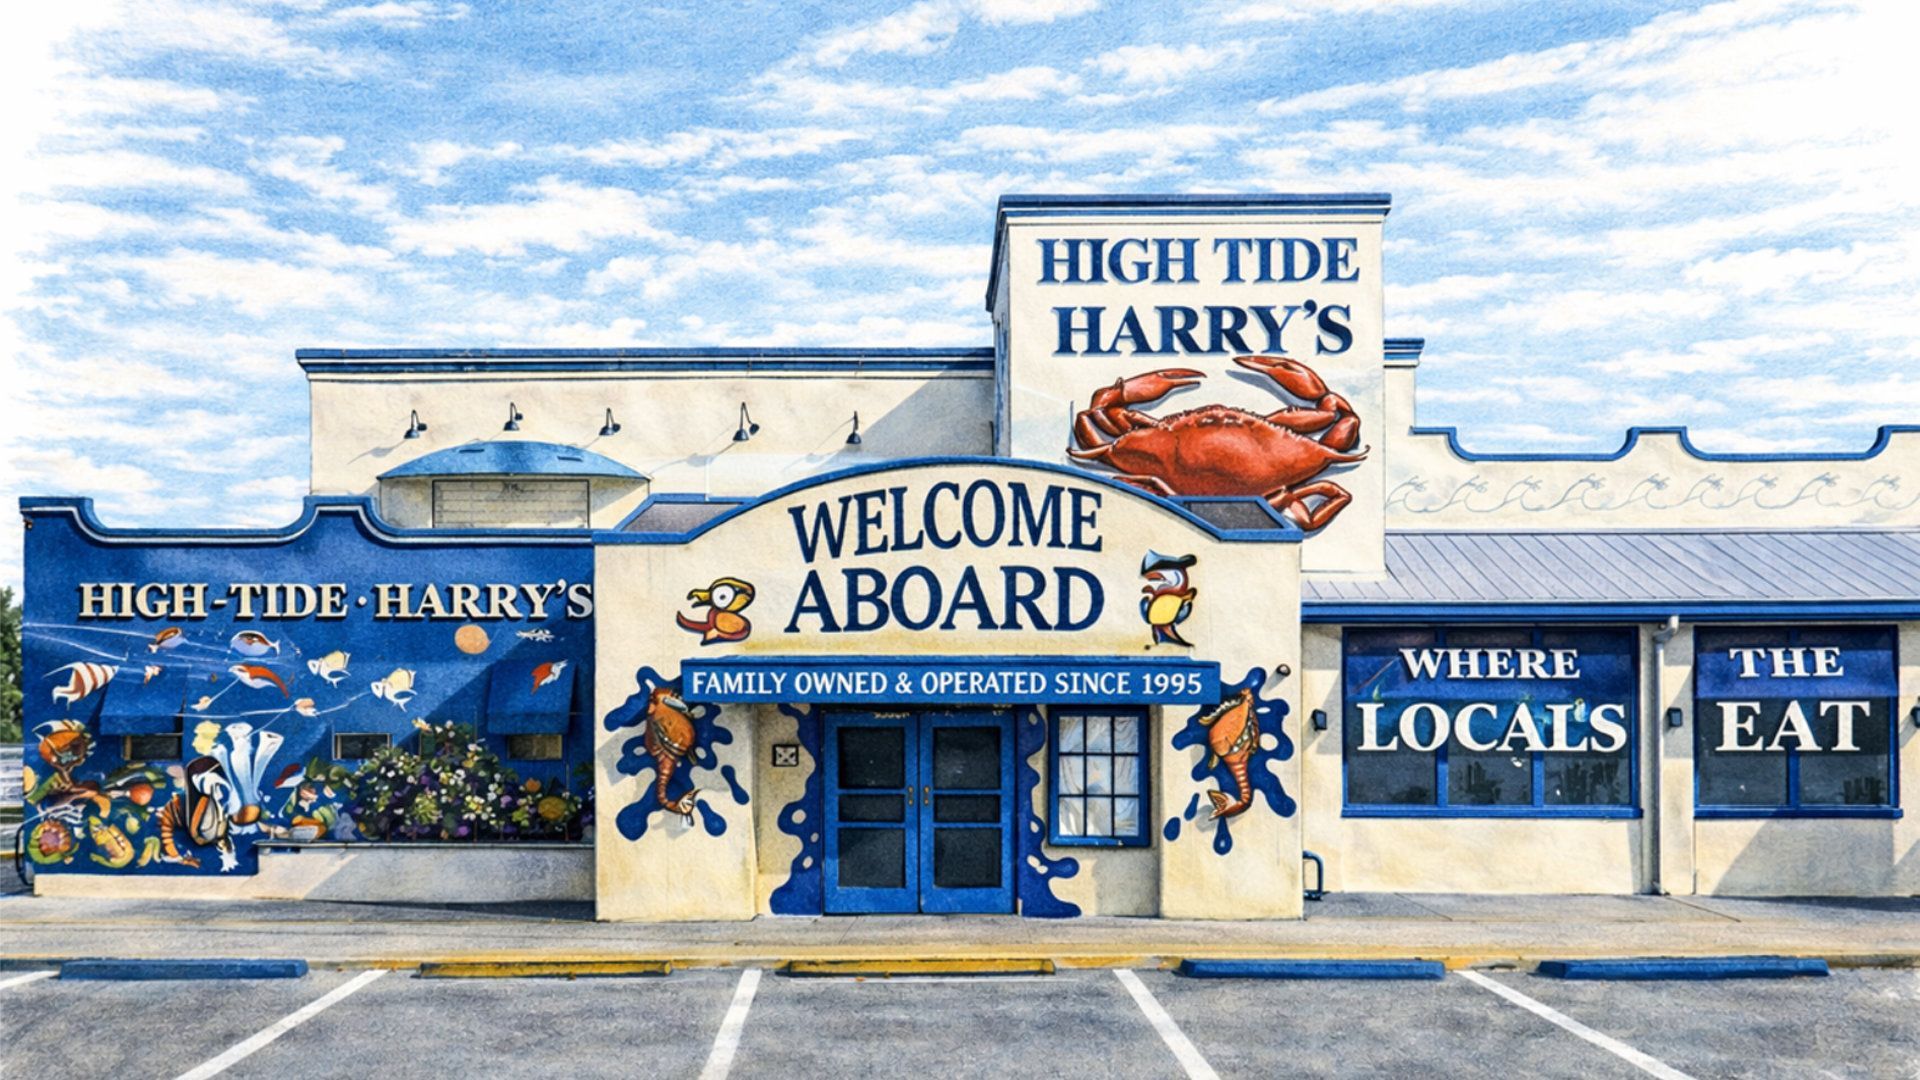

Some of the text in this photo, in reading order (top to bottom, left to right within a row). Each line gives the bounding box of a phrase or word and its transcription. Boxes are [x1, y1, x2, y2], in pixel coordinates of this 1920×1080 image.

[1037, 237, 1360, 284] HIGH TIDE
[1053, 299, 1353, 355] HARRY'S
[788, 478, 1103, 564] WELCOME
[79, 578, 593, 619] HIGH-TIDE HARRY'S
[784, 565, 1105, 634] ABOARD
[692, 671, 1202, 695] FAMILY OWNED & OPERATED SINCE 1995
[1399, 648, 1581, 680] WHERE
[1729, 646, 1845, 678] THE
[1356, 701, 1627, 753] LOCALS
[1715, 700, 1871, 752] EAT
